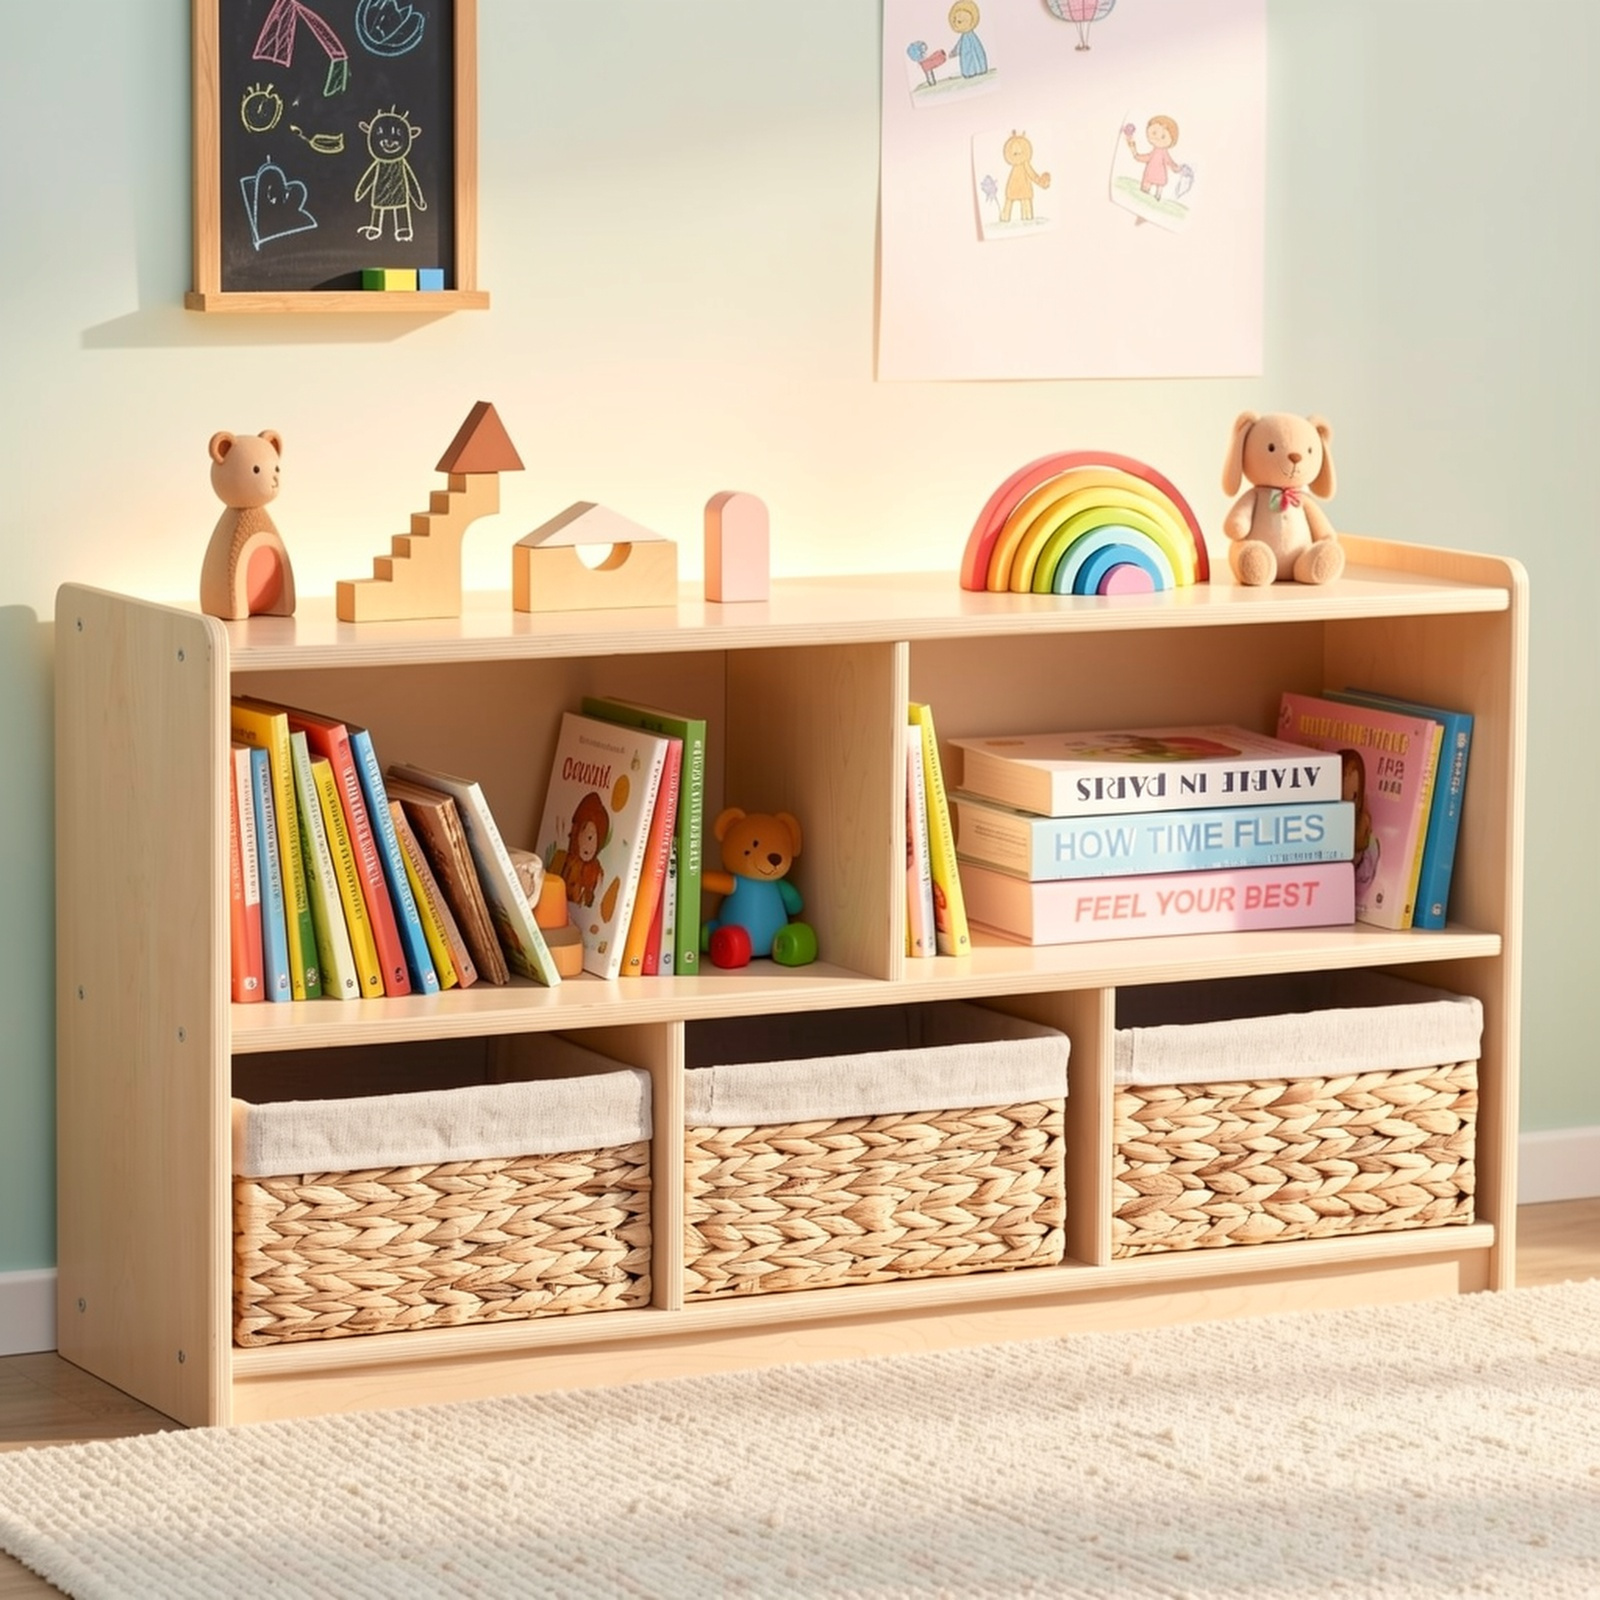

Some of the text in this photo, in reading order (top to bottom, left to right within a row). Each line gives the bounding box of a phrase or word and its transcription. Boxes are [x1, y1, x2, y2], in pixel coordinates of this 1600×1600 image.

[1076, 772, 1167, 801] PARIS
[1180, 772, 1207, 795] IN
[1055, 814, 1325, 862] HOW TIME FLIES
[1074, 881, 1320, 923] FEEL YOUR BEST
